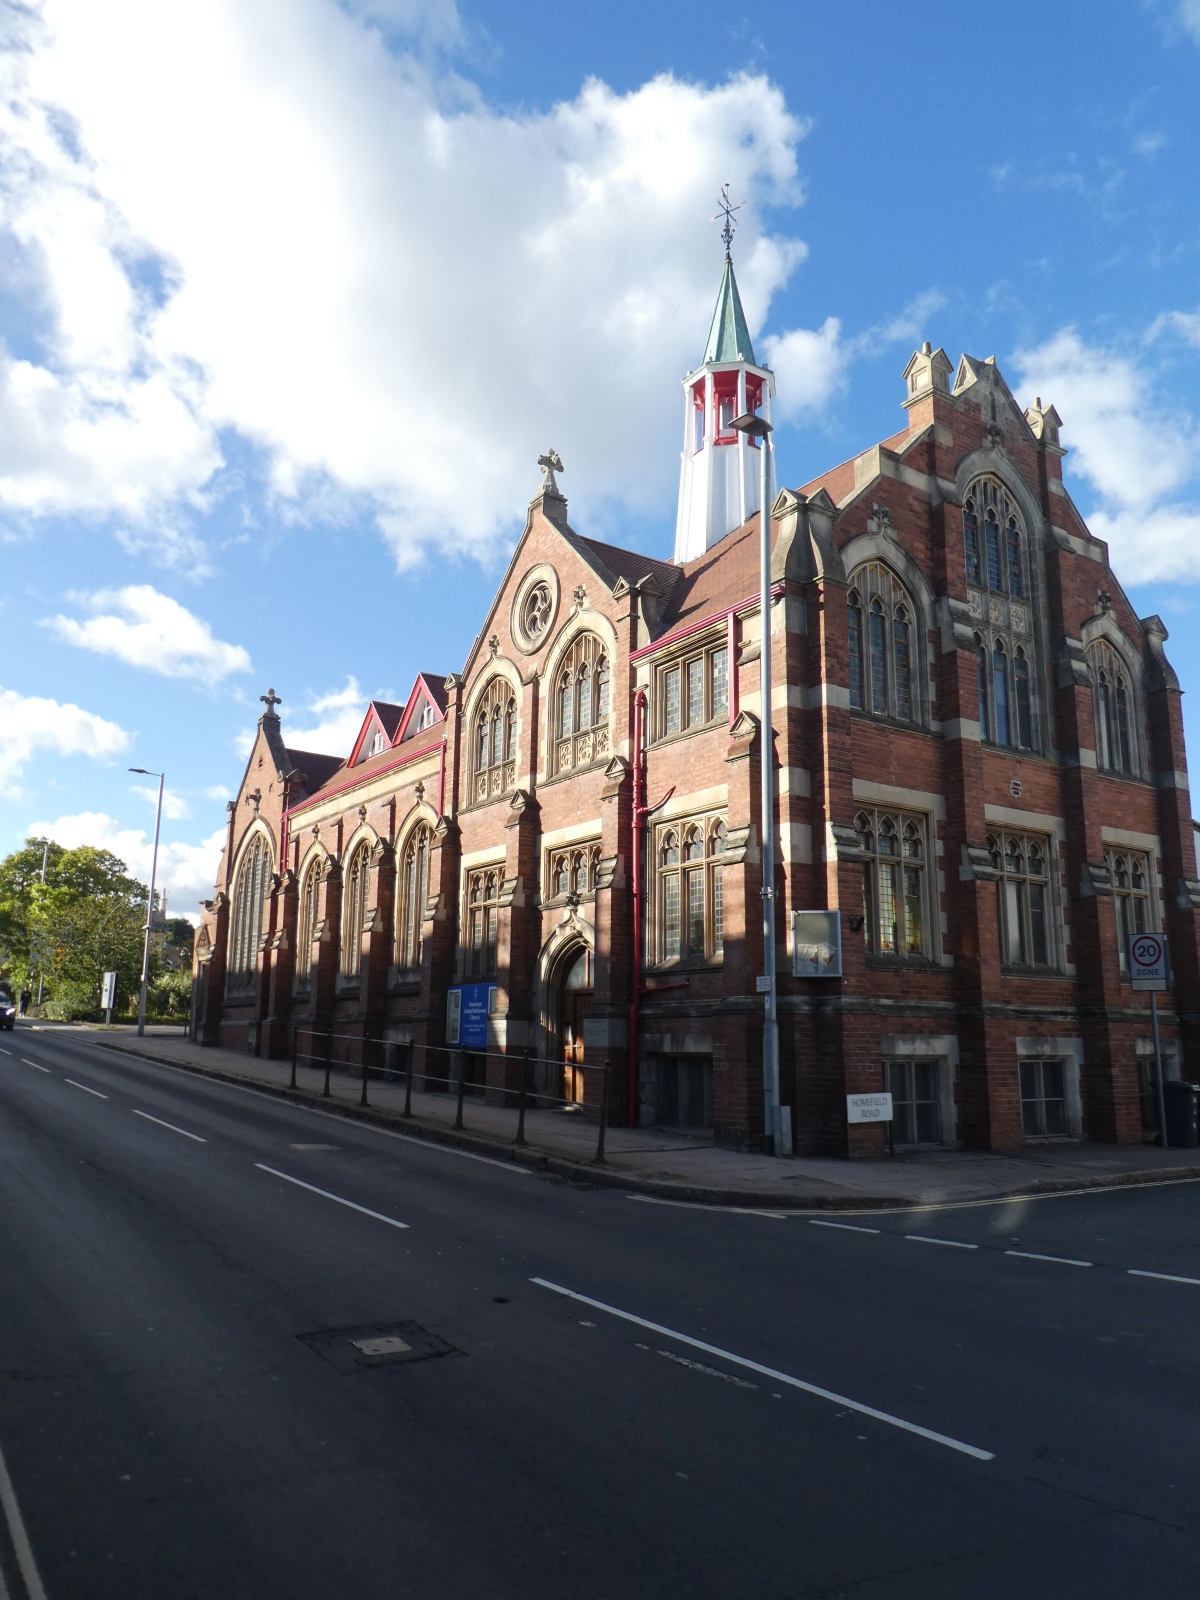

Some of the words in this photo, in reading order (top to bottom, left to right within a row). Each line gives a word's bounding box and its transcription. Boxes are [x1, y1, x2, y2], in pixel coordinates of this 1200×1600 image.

[1138, 944, 1156, 957] 20
[852, 1096, 888, 1107] HOMEFIELD
[861, 1108, 880, 1118] ROAD
